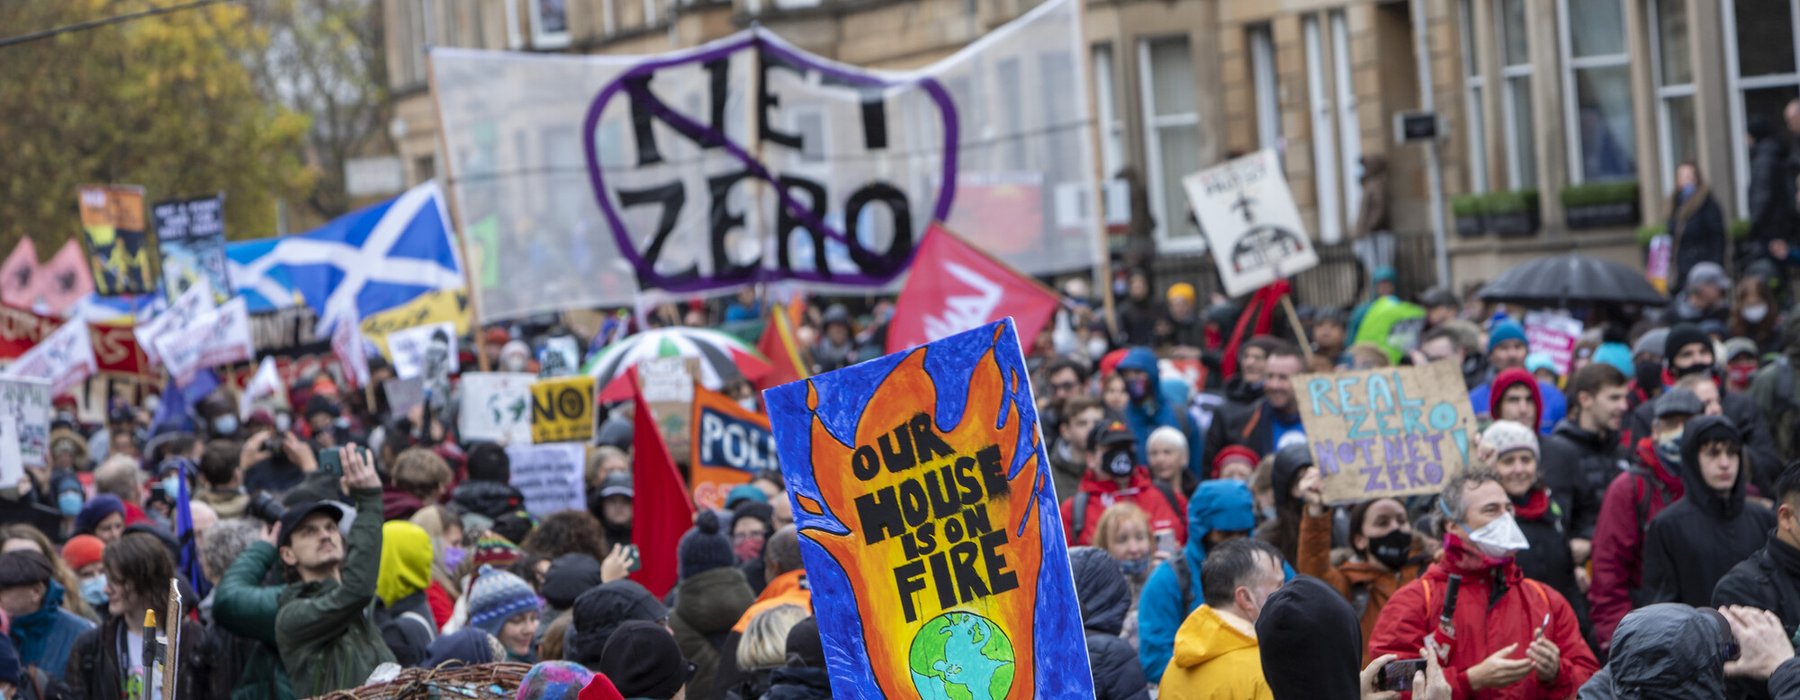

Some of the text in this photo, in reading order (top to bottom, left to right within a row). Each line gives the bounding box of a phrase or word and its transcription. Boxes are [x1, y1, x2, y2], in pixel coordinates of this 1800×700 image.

[615, 168, 912, 291] ZERO
[1307, 371, 1425, 417] REAL
[851, 412, 956, 482] OUR
[1314, 431, 1444, 479] NOT NET
[1359, 461, 1444, 492] ZERO
[853, 444, 1012, 546] HOUSE
[901, 503, 993, 561] IS ON
[893, 528, 1020, 624] FIRE
